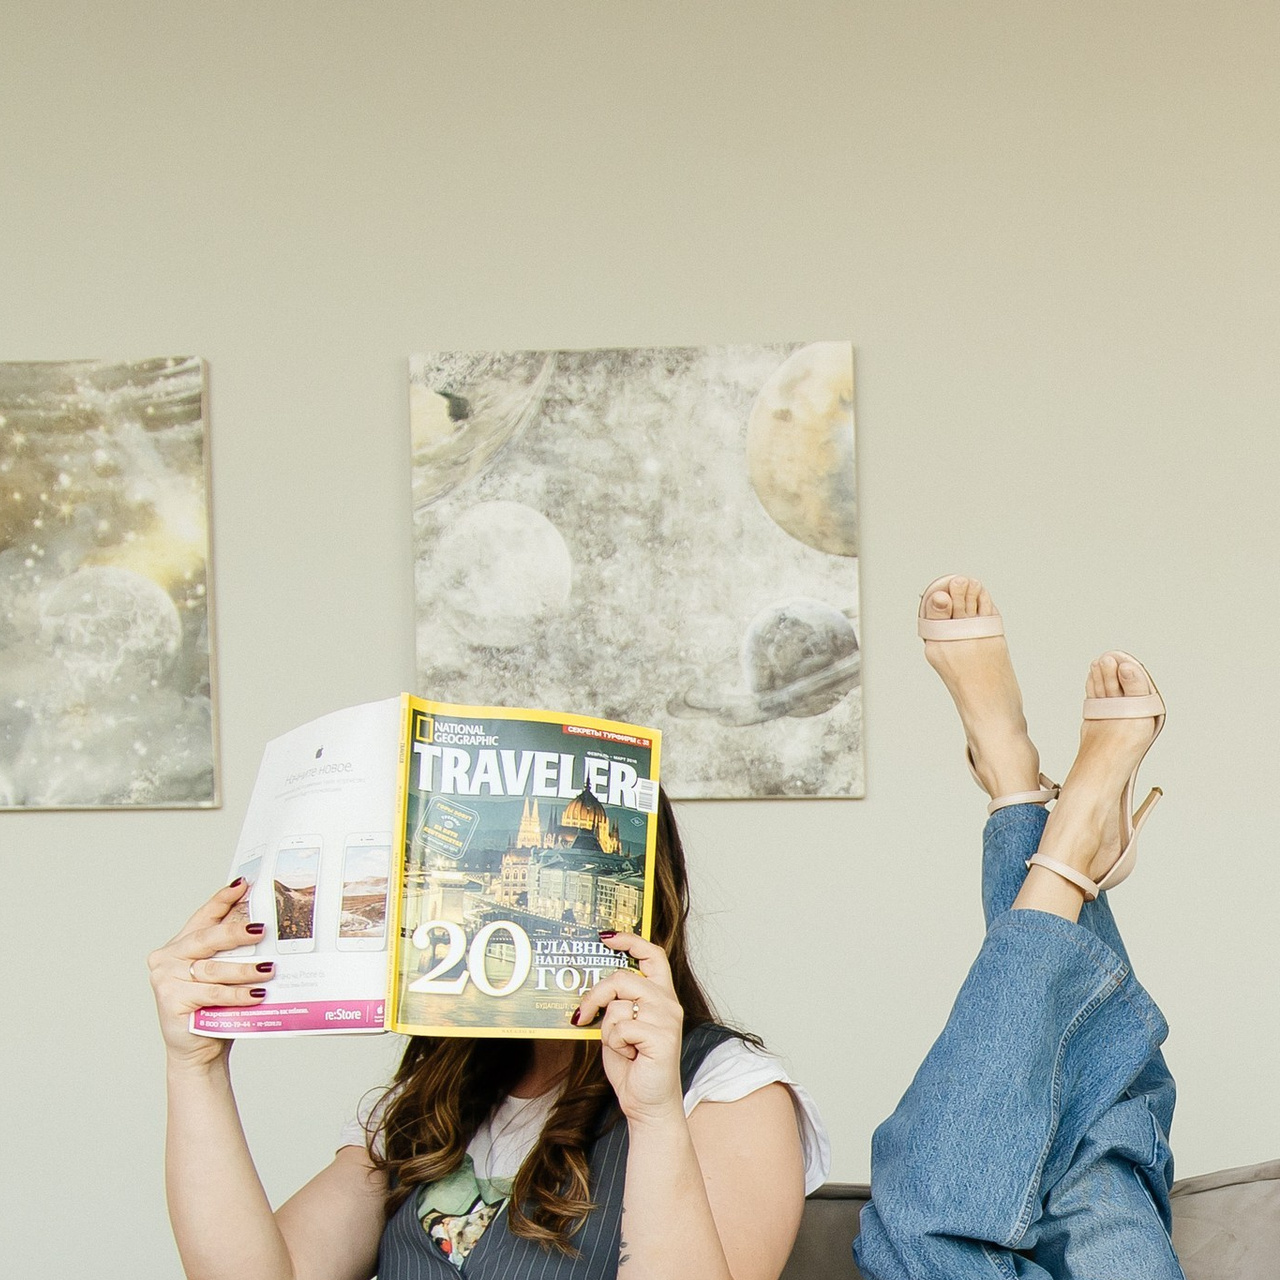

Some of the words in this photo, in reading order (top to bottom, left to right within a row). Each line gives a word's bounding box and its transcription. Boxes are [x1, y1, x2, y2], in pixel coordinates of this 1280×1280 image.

[434, 722, 486, 736] NATIONAL
[567, 726, 602, 737] СЕКРЕТЫ
[434, 733, 500, 746] GEOGRAPHIC
[413, 742, 641, 809] TRAVELER
[408, 920, 533, 998] 20
[535, 954, 629, 969] НАПРАВЛЕНИЙ
[535, 966, 606, 996] ГОД
[325, 1008, 362, 1020] re:Store
